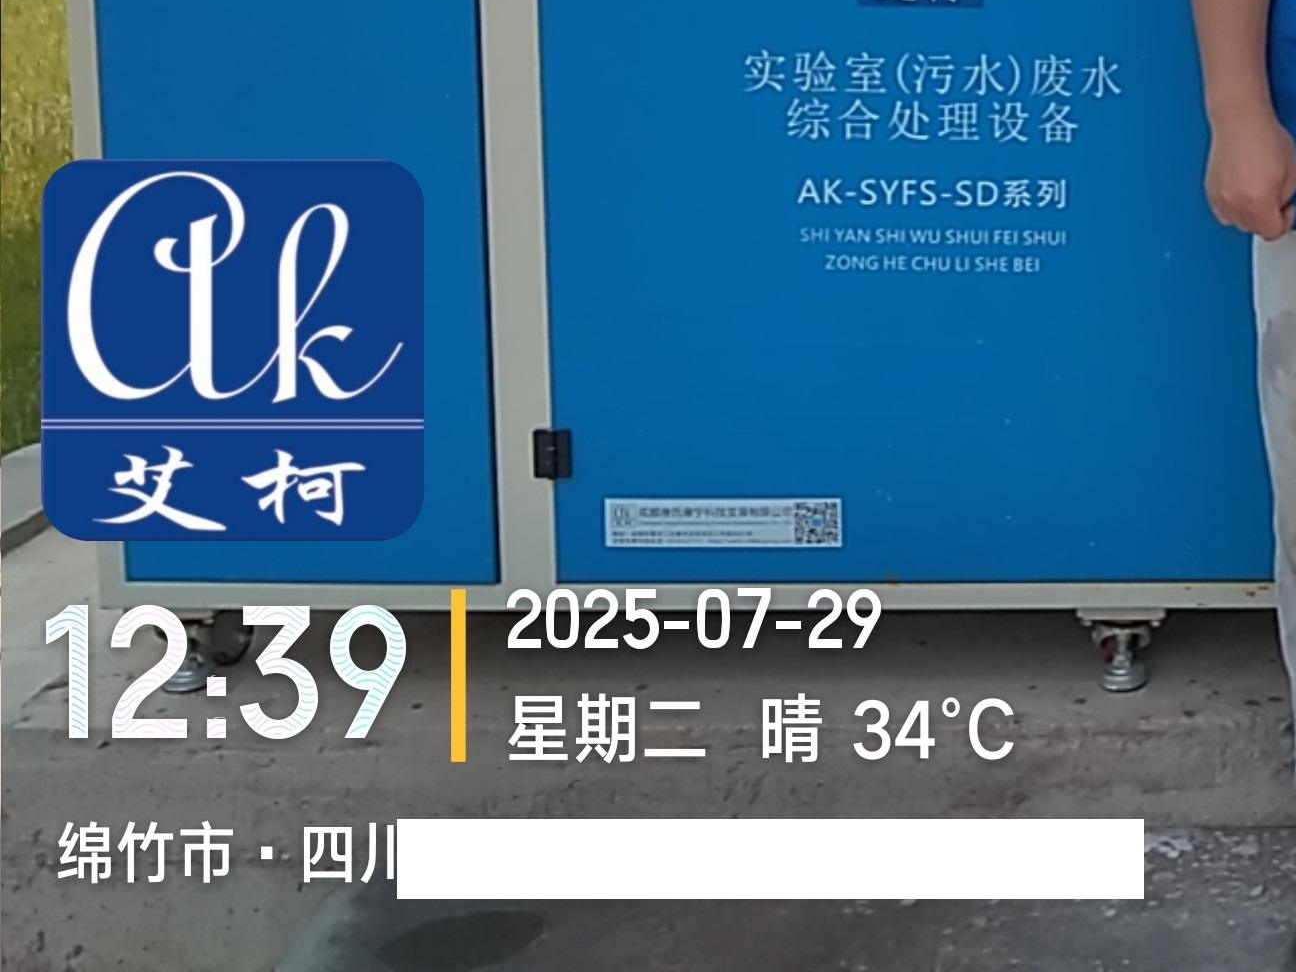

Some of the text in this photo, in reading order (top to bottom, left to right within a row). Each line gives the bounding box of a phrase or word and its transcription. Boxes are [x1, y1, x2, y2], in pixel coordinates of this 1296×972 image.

[743, 49, 1123, 99] 实验室(污水)废水
[786, 97, 1079, 144] 综合处理设备
[797, 178, 1067, 209] AK-SYFS-SD系列
[800, 227, 1067, 244] SHI YAN SHI WU SHUI FEI SHUI
[825, 254, 1041, 271] ZONG HE CHU LI SHE BEI
